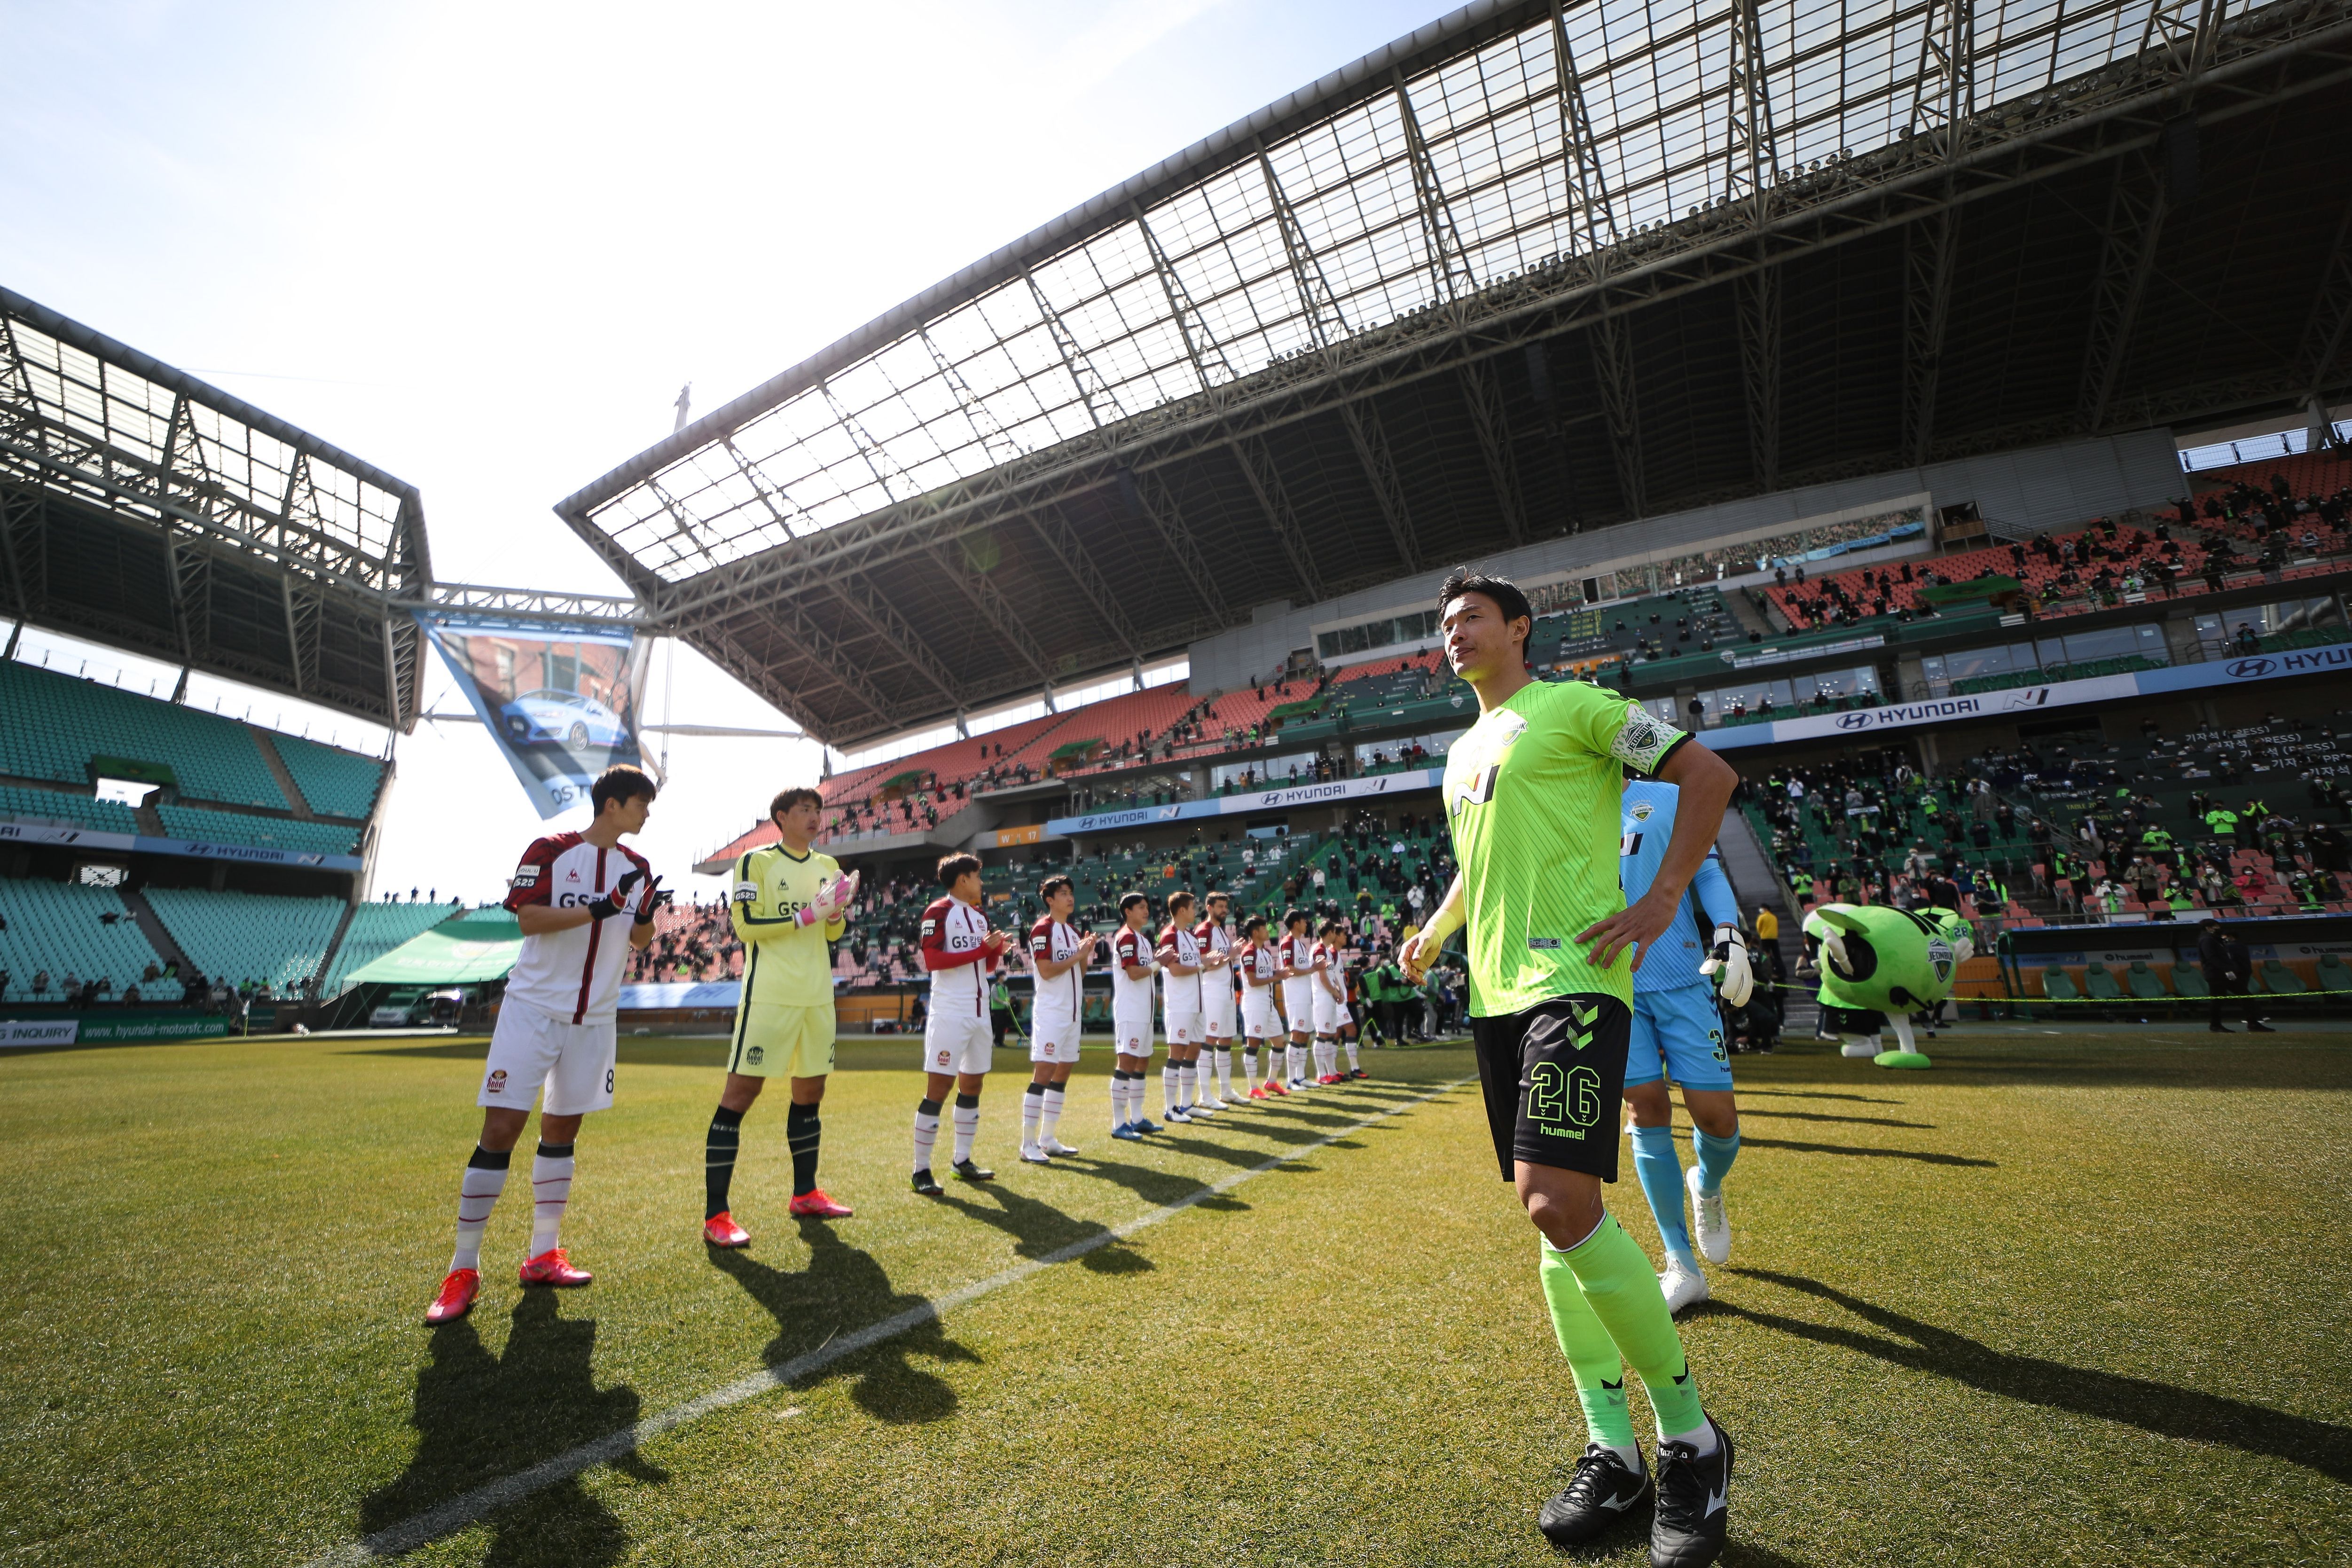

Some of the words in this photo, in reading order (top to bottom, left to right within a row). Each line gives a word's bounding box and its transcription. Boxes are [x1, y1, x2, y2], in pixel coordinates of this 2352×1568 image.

[1879, 699, 1980, 723] HYUNDAI
[1628, 721, 1654, 754] JEONBUK
[2223, 726, 2270, 737] (RESS)
[2260, 733, 2301, 743] RESS)
[2240, 746, 2279, 758] 기석
[2283, 741, 2336, 755] (PESS)
[1286, 785, 1346, 802] HYUNDAI
[1099, 810, 1148, 826] HYUNDAI
[1028, 831, 1037, 840] 17
[217, 847, 284, 861] HYUNDAI
[514, 878, 535, 887] S25
[735, 892, 756, 901] GS25
[2115, 952, 2153, 961] hummel
[2313, 946, 2352, 954] humme
[13, 1027, 71, 1039] INQUIRY
[605, 1068, 614, 1094] 8
[1527, 1061, 1600, 1127] 26
[1540, 1123, 1585, 1141] hummel
